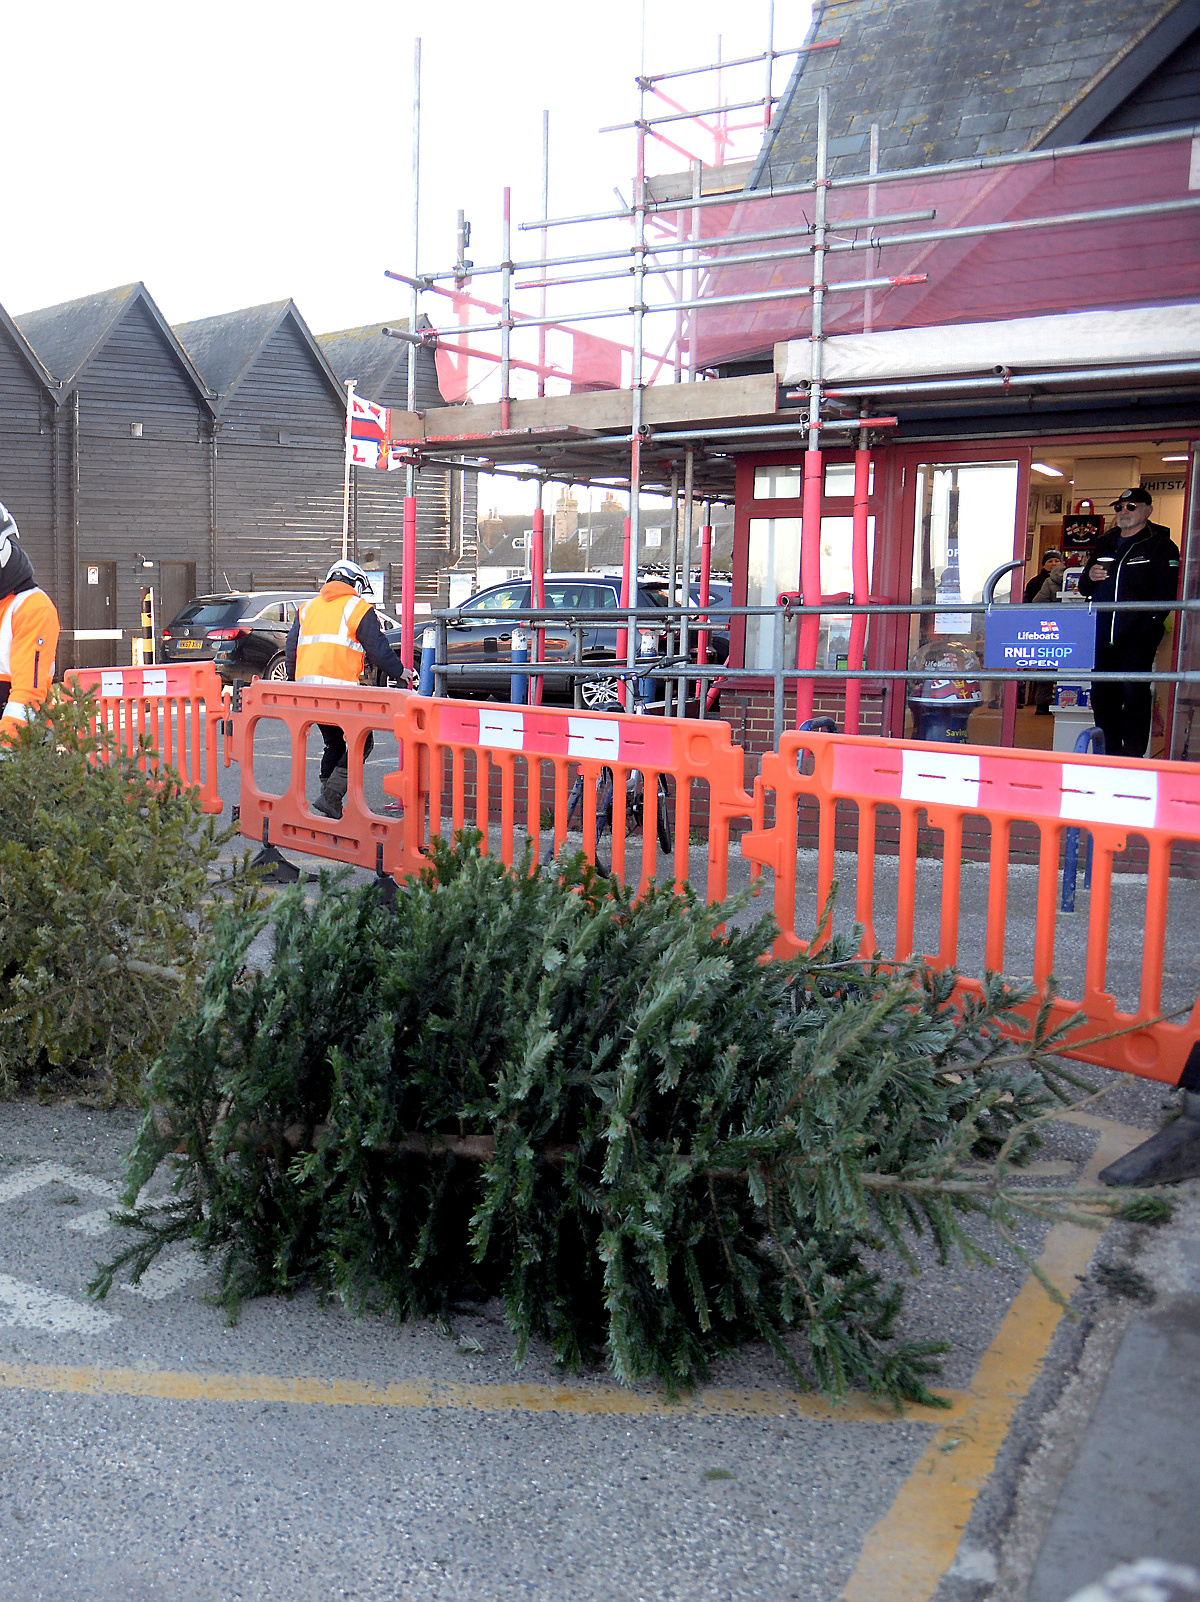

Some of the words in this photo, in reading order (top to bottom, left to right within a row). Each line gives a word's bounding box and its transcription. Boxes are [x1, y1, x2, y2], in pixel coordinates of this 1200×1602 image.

[1017, 631, 1060, 640] Lifeboats
[1004, 647, 1035, 658] RNLI
[1037, 647, 1073, 658] SHOP
[1015, 659, 1059, 667] OPEN
